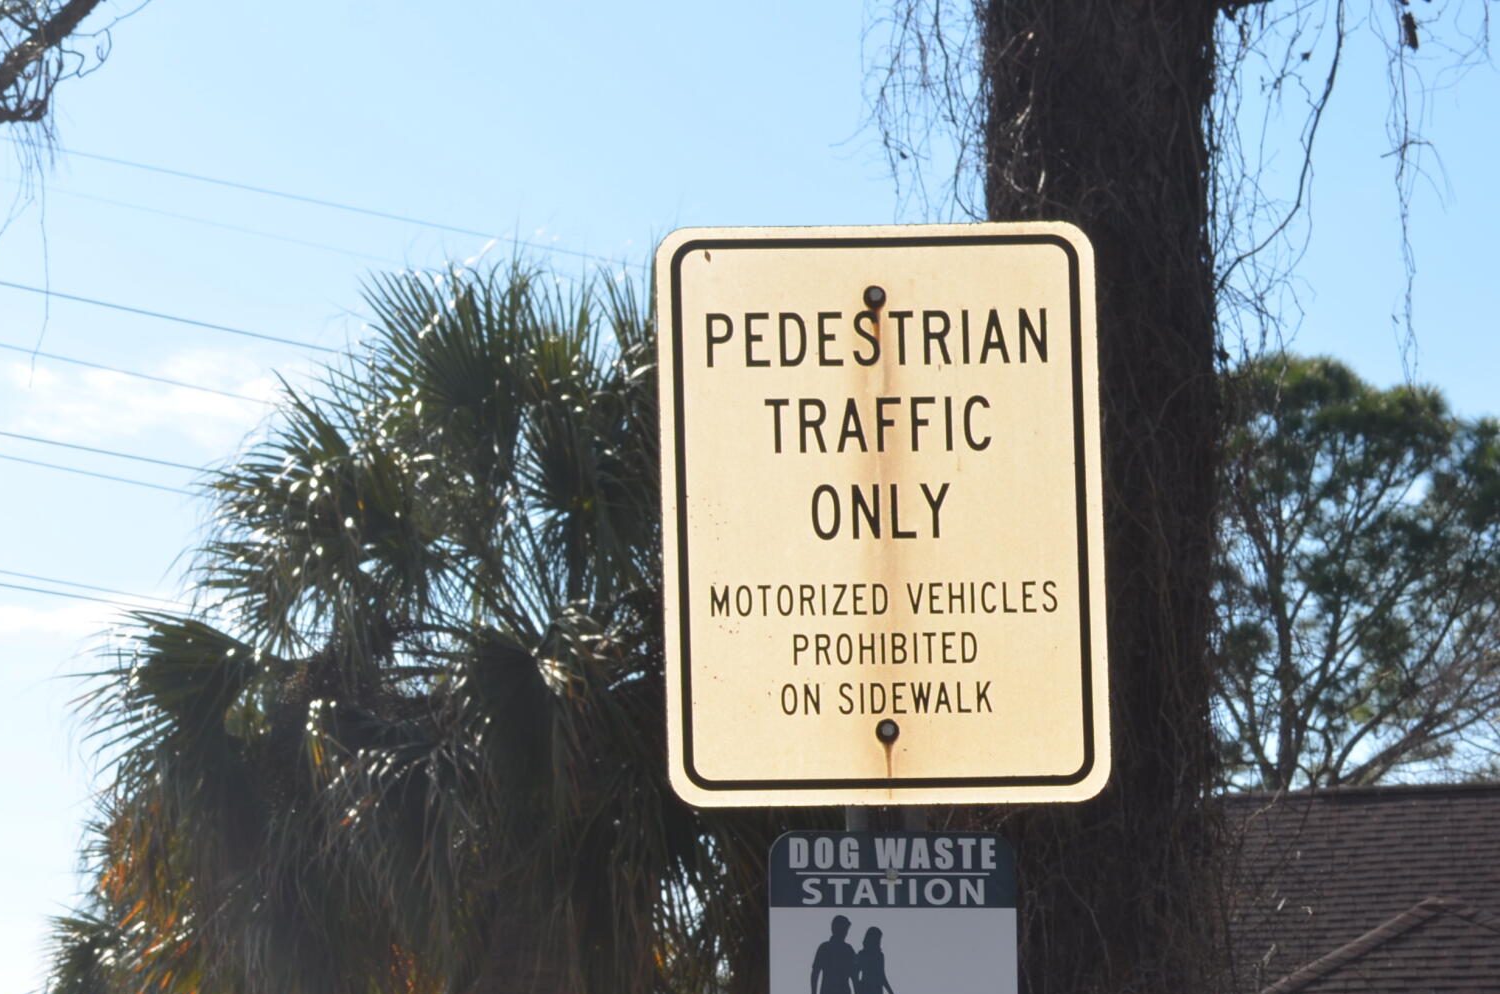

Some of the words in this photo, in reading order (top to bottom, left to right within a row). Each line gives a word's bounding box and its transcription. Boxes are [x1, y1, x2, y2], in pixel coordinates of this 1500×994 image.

[706, 308, 1047, 367] PEDESTRIAN
[765, 396, 991, 453] TRAFFIC
[812, 483, 949, 540] ONLY
[711, 584, 888, 616] MOTORIZED
[907, 581, 1057, 614] VEHICLES
[794, 632, 977, 665] PROHIBITED
[782, 684, 820, 715] ON
[839, 681, 992, 714] SIDEWALK
[789, 837, 859, 869] DOG
[875, 838, 996, 869] WASTE
[803, 878, 984, 905] STATION
